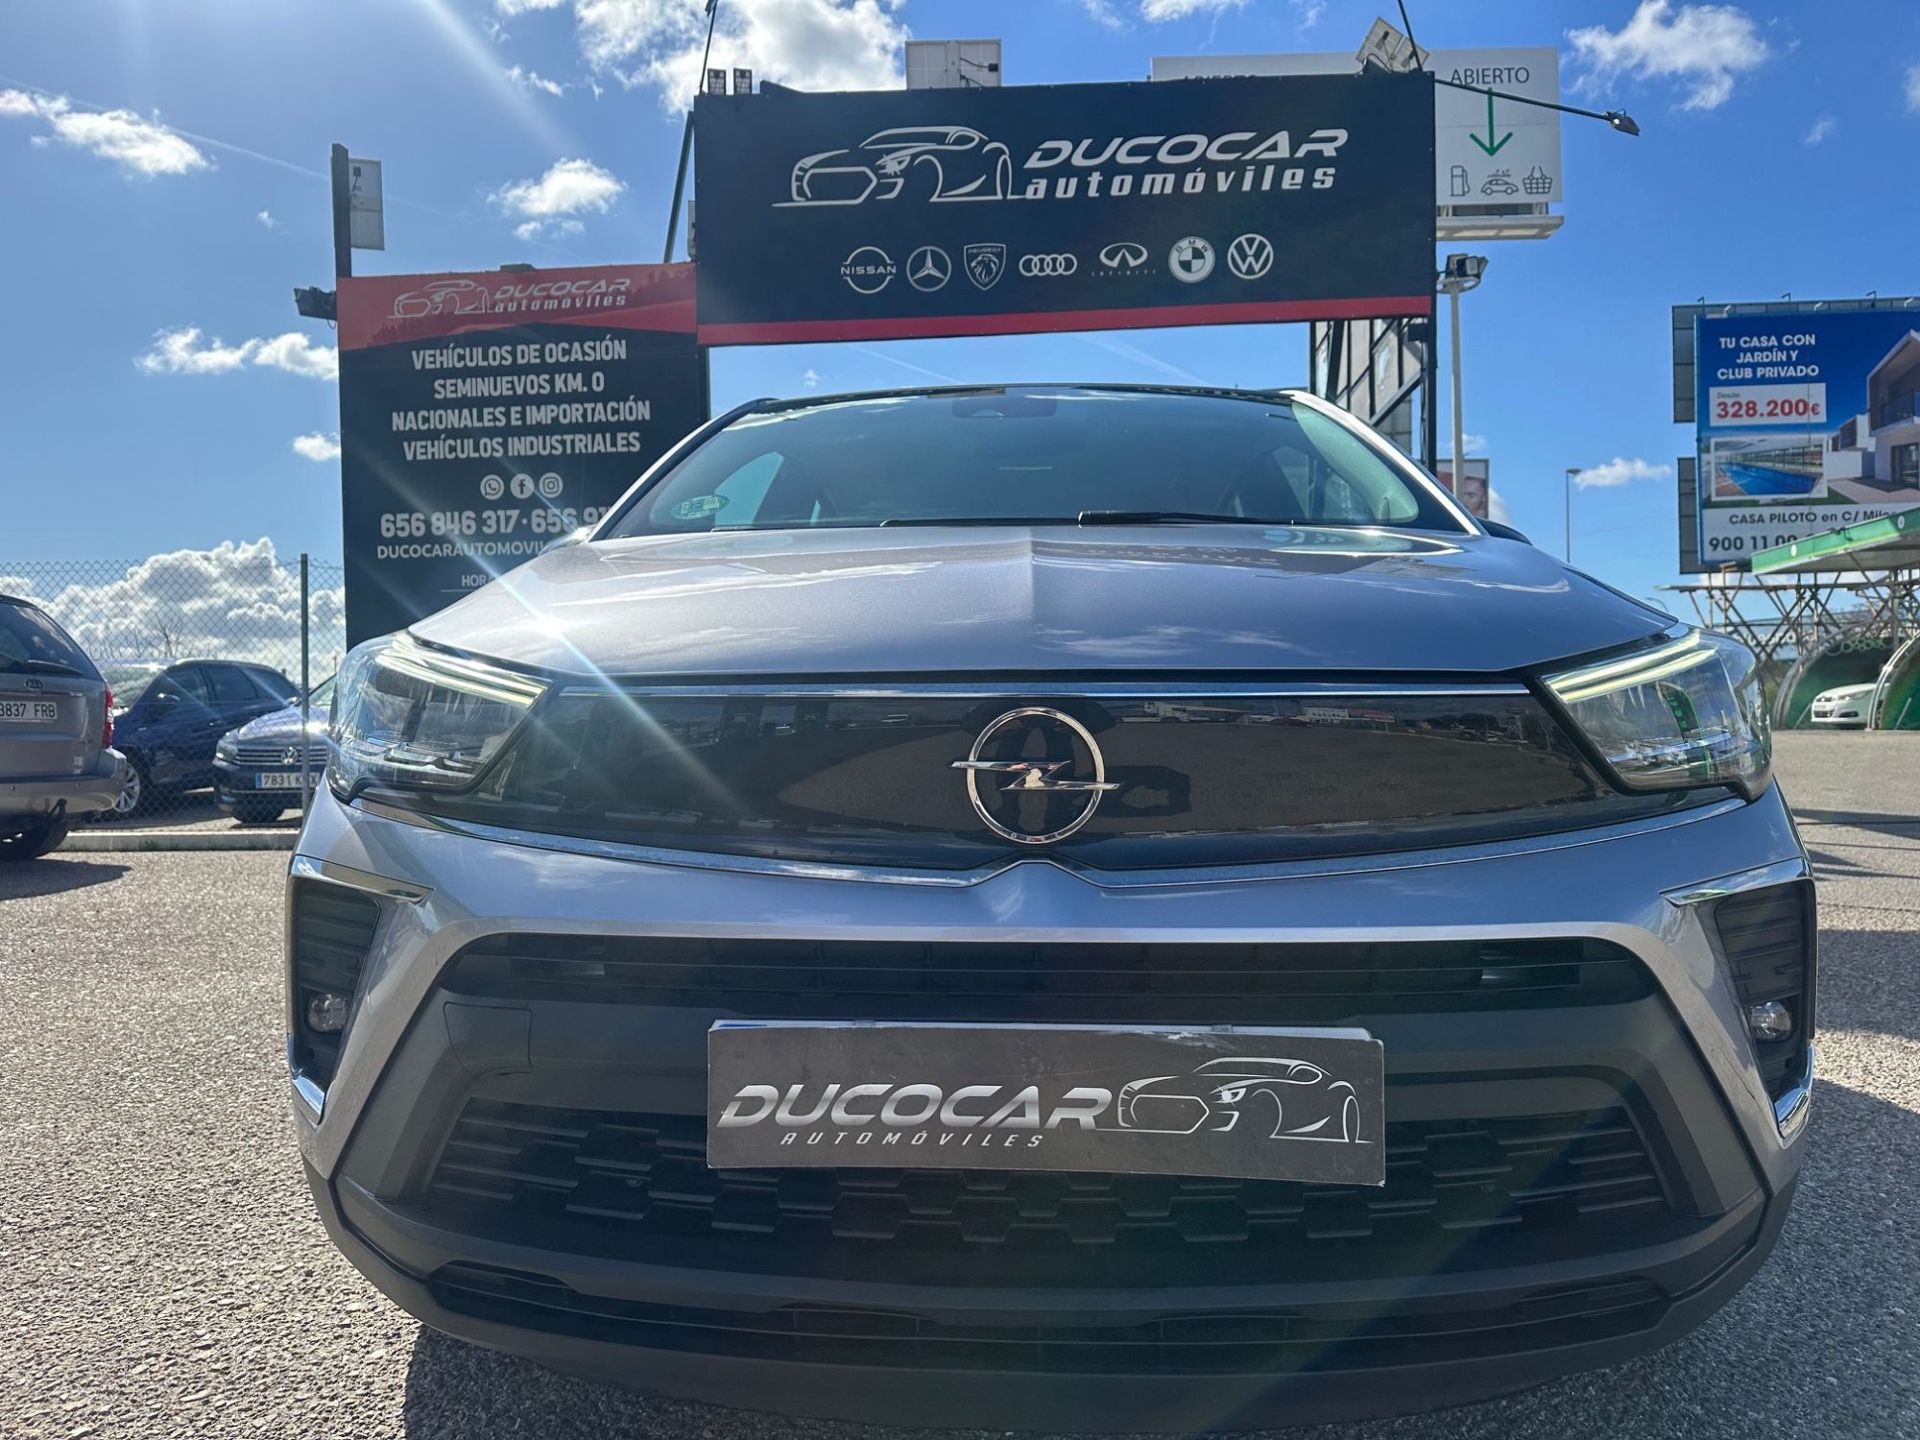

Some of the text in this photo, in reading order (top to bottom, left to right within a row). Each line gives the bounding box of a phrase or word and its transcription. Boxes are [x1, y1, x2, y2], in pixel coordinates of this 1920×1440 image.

[1451, 67, 1530, 85] ABIERTO
[1023, 129, 1349, 169] DUCOCAR
[1025, 165, 1336, 199] automóviles
[841, 265, 897, 275] NISSAN
[494, 278, 631, 299] DUCOCAR
[1719, 333, 1816, 349] TU CASA CON
[411, 334, 627, 370] VEHÍCULOS DE OCASIÓN
[1736, 347, 1799, 363] JARDÍN Y
[1717, 364, 1820, 380] CLUB PRIVADO
[433, 374, 551, 399] SEMINUEVOS
[555, 372, 588, 393] KM.
[392, 395, 651, 431] NACIONALES E IMPORTACIÓN
[403, 431, 641, 461] VEHÍCULOS INDUSTRIALES
[380, 513, 426, 538] 656
[430, 510, 477, 535] 846
[1729, 513, 1765, 525] CASA
[1769, 510, 1818, 524] PILOTO
[1821, 512, 1838, 522] en
[1708, 536, 1744, 552] 900
[1750, 536, 1768, 550] 11
[33, 703, 56, 719] FRB
[263, 774, 318, 787] 7831 KX
[716, 1083, 1113, 1130] DUCOCAR
[780, 1131, 1044, 1147] AUTOMÓVILES
